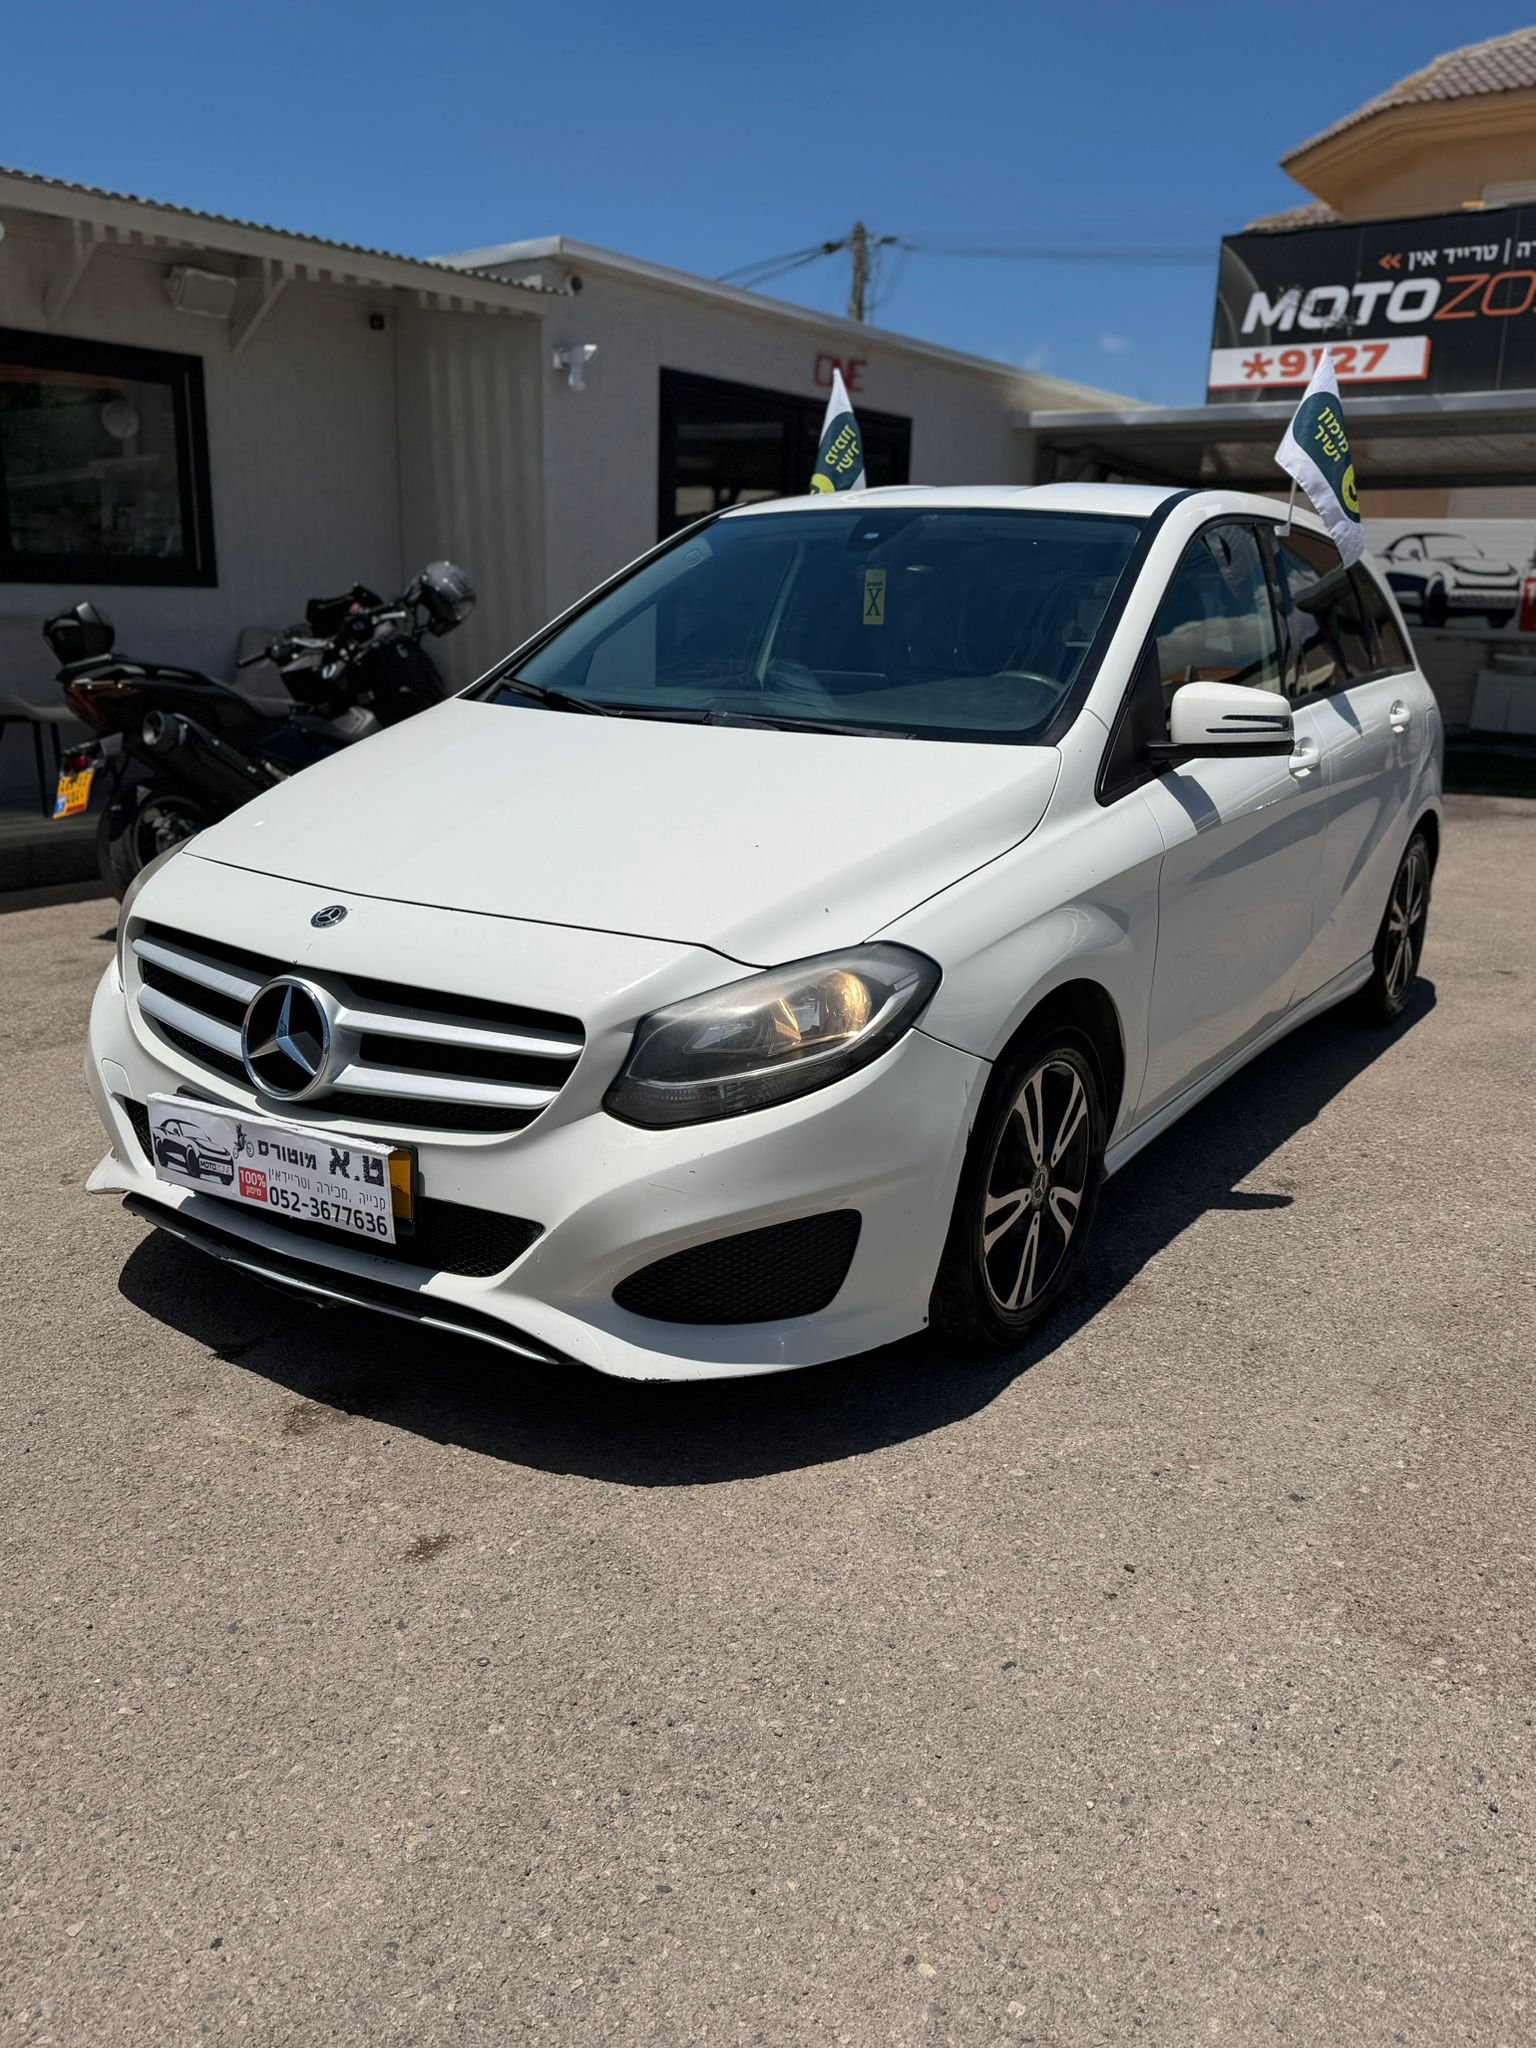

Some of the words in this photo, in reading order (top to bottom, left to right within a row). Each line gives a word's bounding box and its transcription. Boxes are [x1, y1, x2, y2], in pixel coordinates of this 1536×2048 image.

[1408, 249, 1438, 272] אין
[1443, 244, 1499, 264] טרייד
[1241, 270, 1536, 335] MOTOZO
[1314, 424, 1342, 462] ישיר
[1317, 406, 1349, 454] מימון
[257, 1140, 317, 1170] מוטורס
[239, 1170, 266, 1188] 100%
[269, 1186, 388, 1236] 052-3677636
[359, 1192, 386, 1211] קנייה
